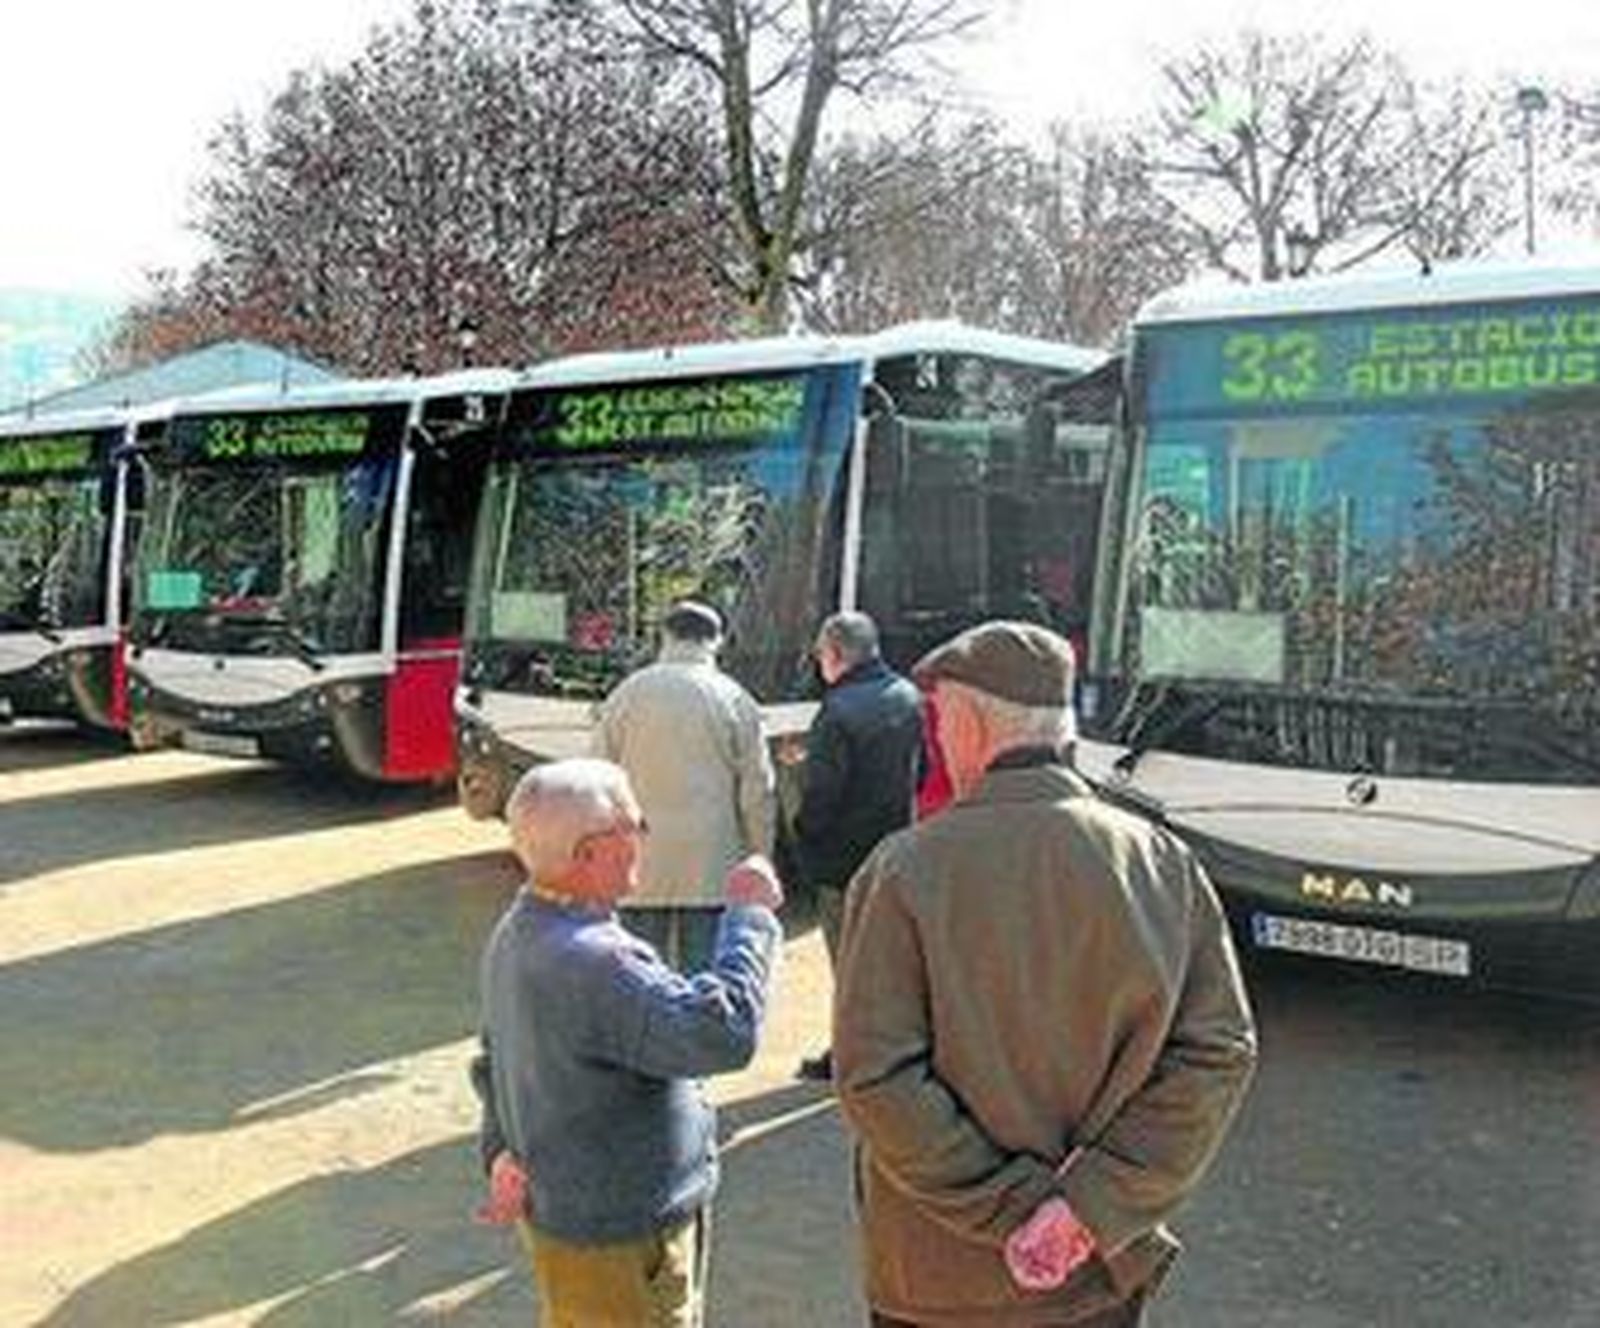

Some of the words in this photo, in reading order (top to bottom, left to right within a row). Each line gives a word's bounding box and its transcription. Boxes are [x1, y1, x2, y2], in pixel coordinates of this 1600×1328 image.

[1222, 333, 1318, 399] 33
[1350, 352, 1596, 394] AUTOBUS
[207, 419, 246, 458] 33
[557, 394, 612, 447] 33
[1302, 872, 1412, 906] MAN
